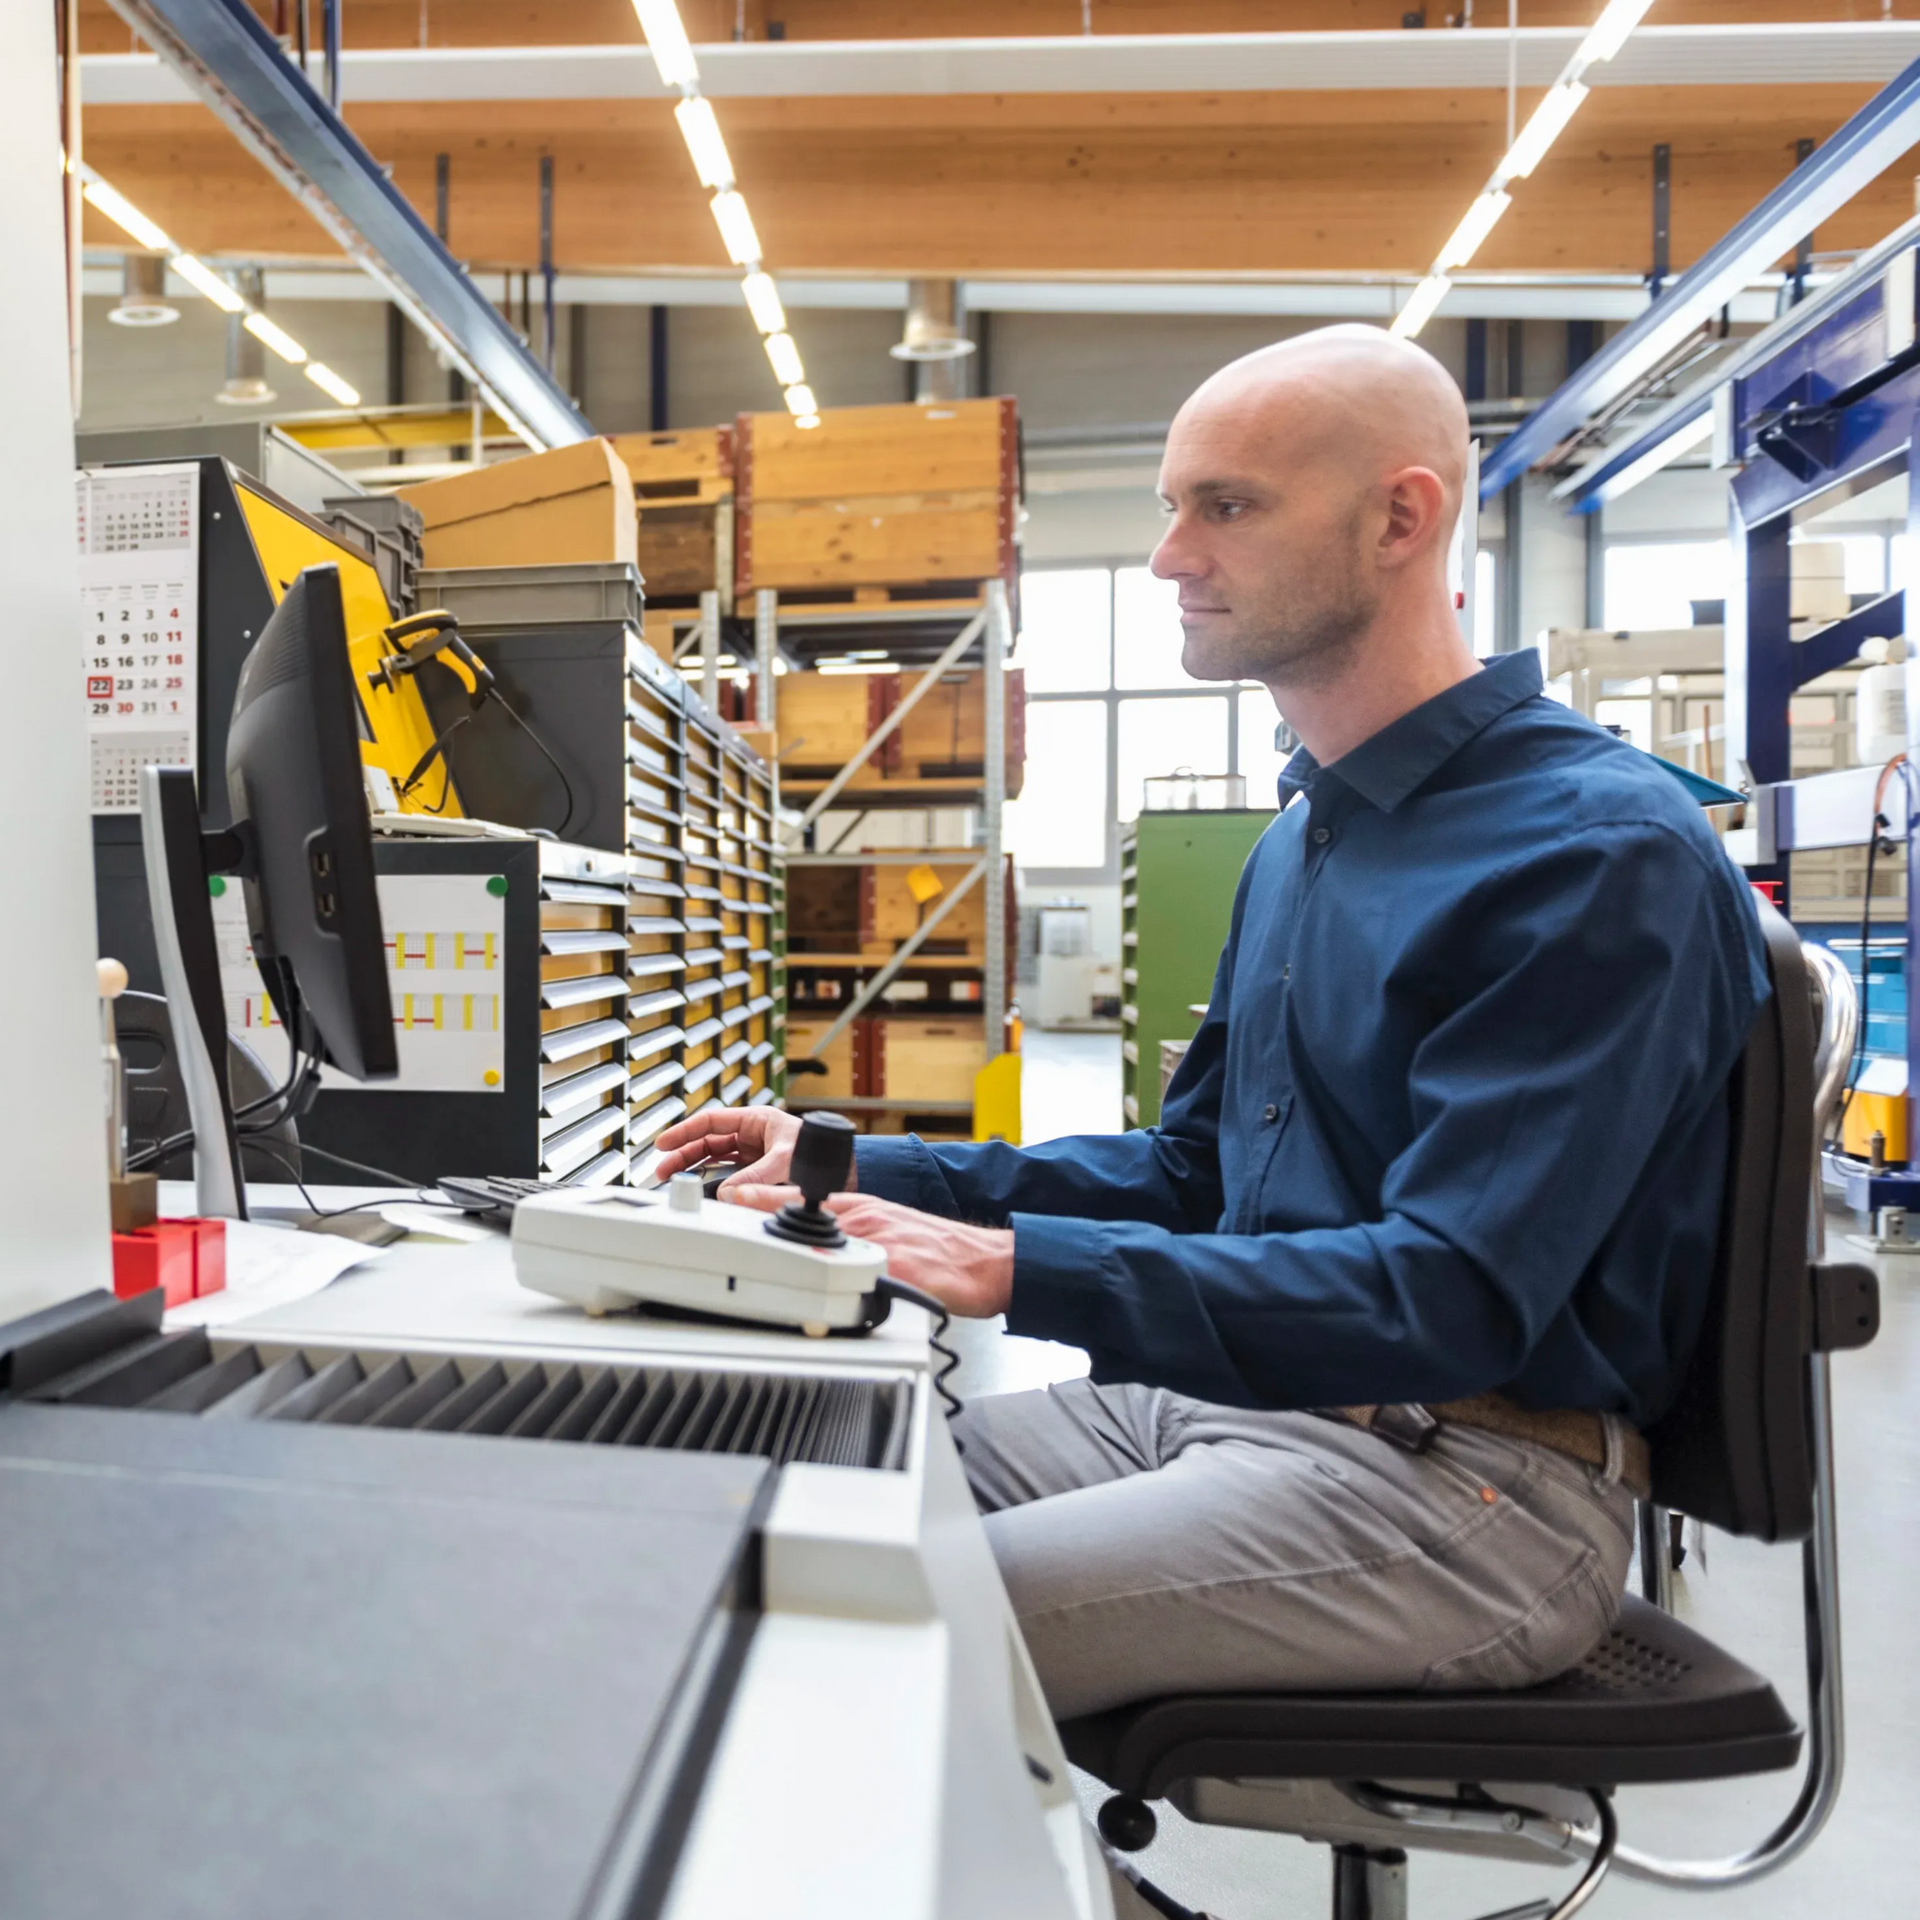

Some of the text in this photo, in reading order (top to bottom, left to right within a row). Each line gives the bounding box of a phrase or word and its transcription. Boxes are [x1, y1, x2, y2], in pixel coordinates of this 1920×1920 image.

[97, 608, 179, 622] 1 2 3 4
[97, 631, 182, 645] 8 9 10 11
[93, 658, 109, 668] 15
[118, 656, 133, 667] 16
[142, 656, 158, 666] 17
[167, 654, 182, 665] 18
[93, 678, 182, 691] 22 23 24 25
[93, 701, 177, 714] 29 30 31 1
